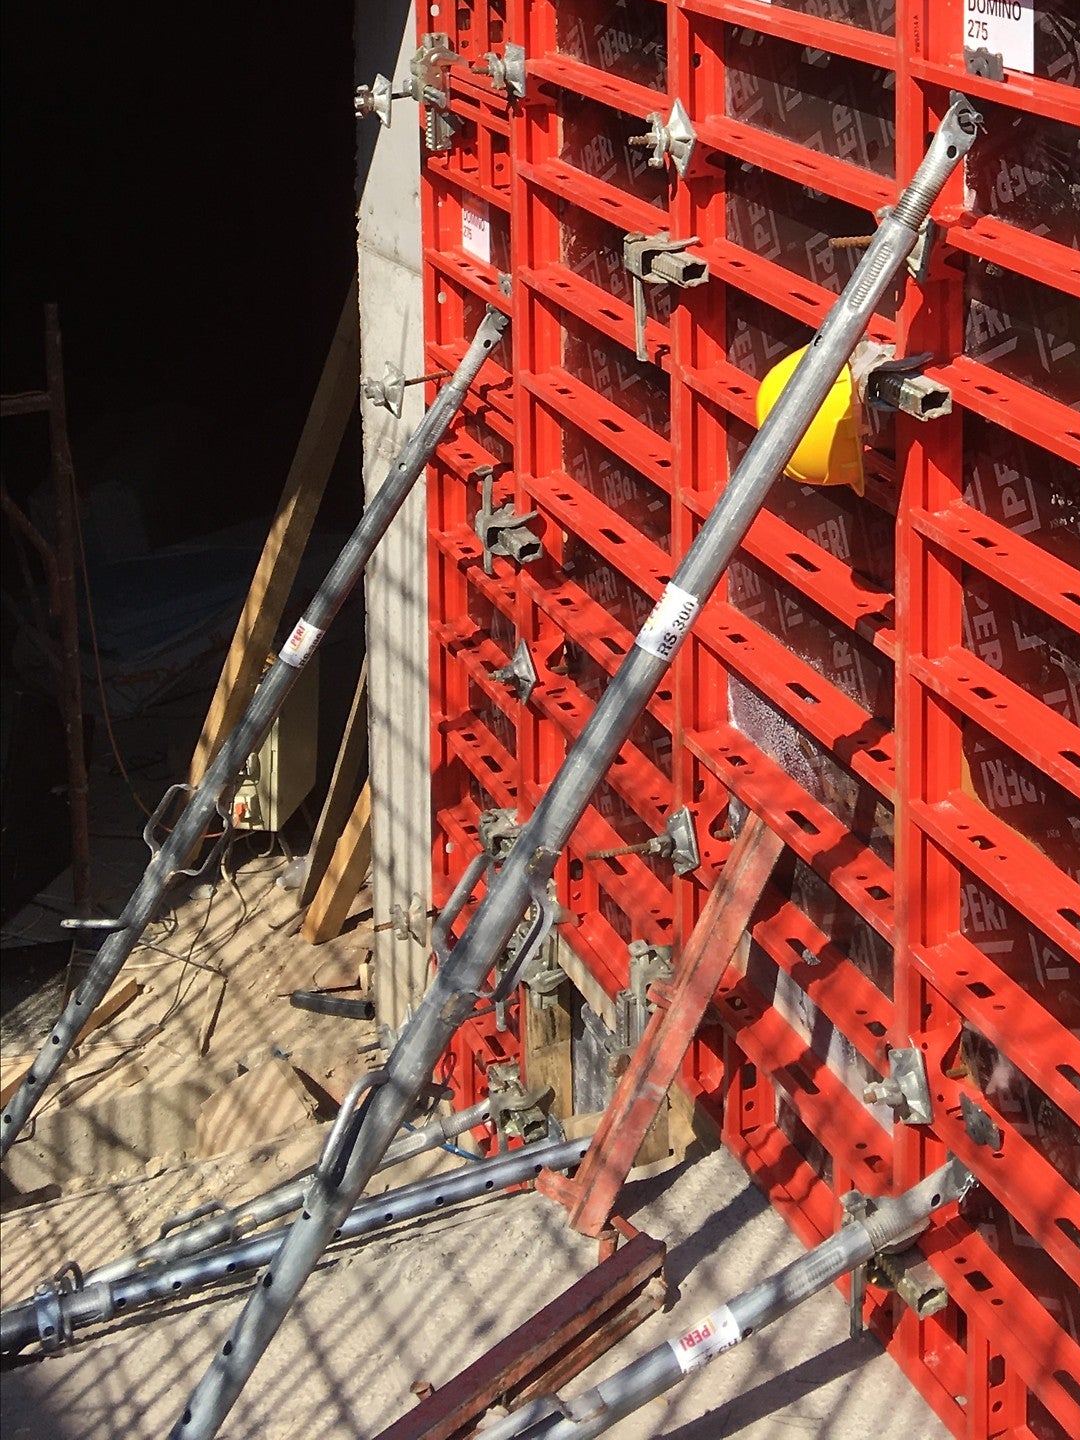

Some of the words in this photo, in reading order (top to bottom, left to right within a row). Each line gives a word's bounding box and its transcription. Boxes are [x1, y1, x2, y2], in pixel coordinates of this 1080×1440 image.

[967, 19, 988, 41] 275
[290, 625, 305, 647] PERI
[657, 632, 677, 656] RS
[673, 601, 695, 631] 300
[679, 1324, 712, 1352] PERI
